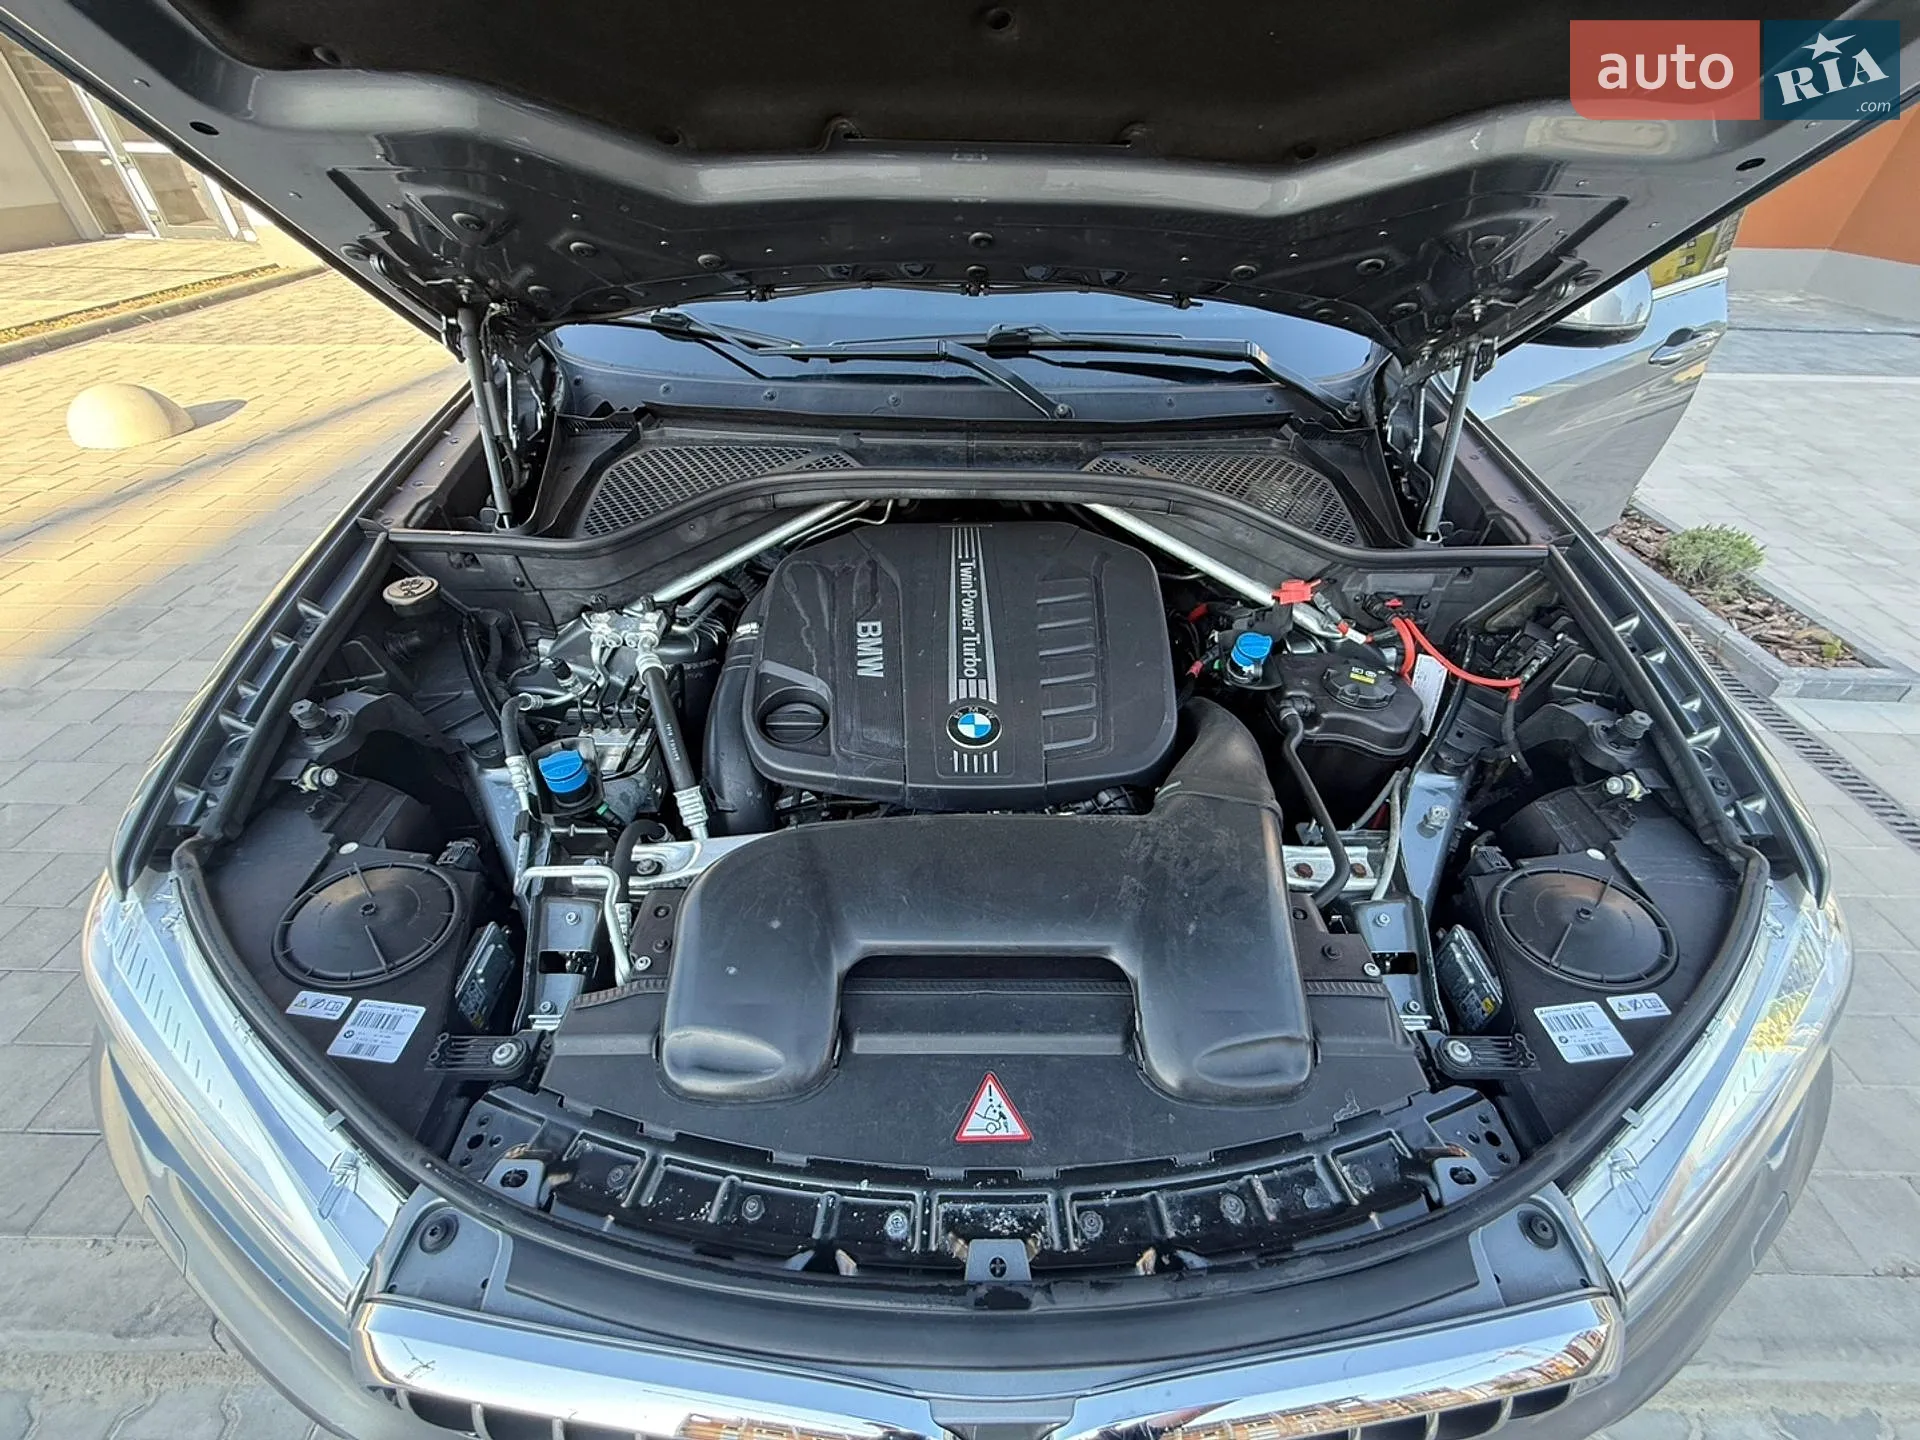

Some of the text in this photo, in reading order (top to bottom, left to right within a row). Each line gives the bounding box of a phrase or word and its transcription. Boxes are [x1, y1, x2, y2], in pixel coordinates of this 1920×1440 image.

[856, 620, 884, 678] BMW
[960, 559, 982, 678] TwinPower Turbo
